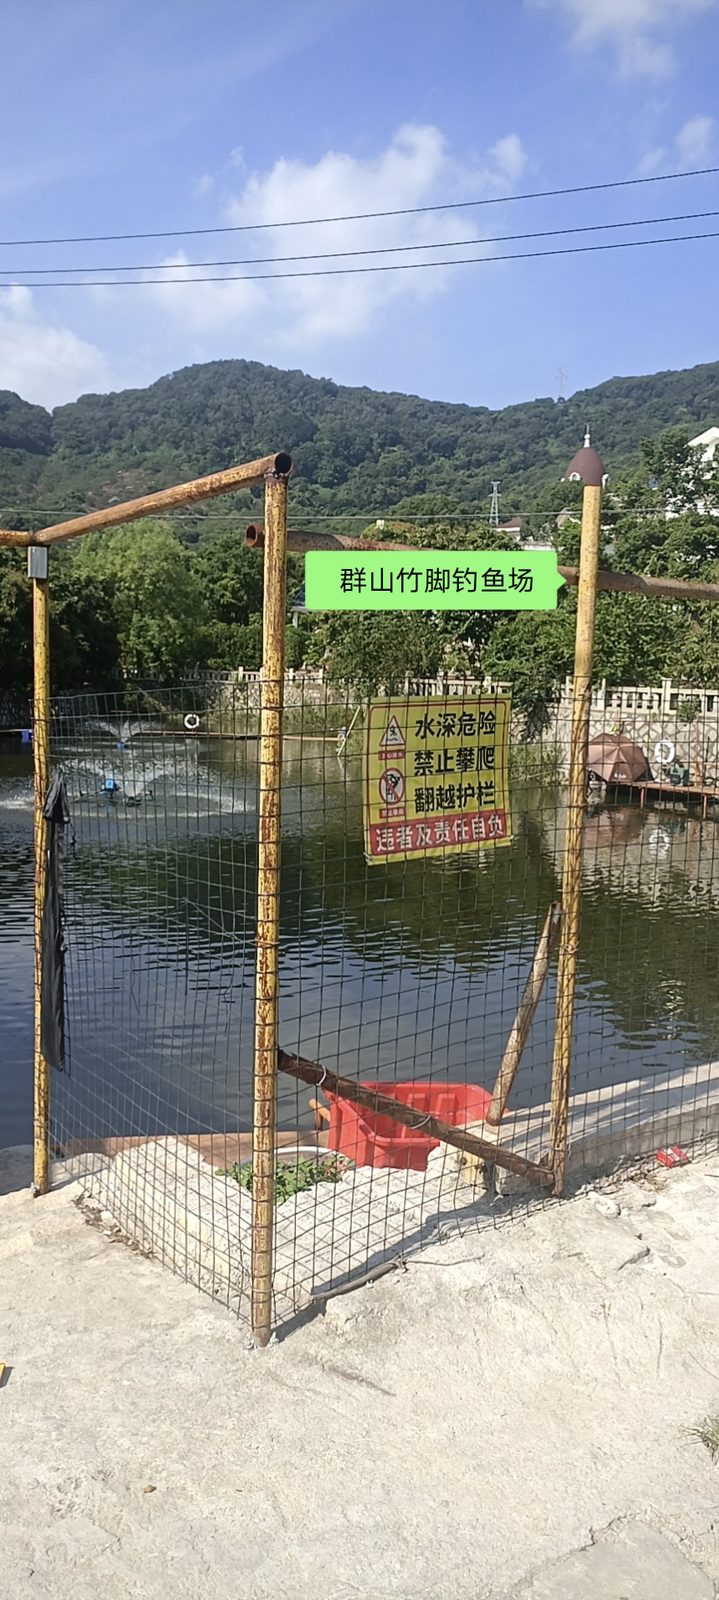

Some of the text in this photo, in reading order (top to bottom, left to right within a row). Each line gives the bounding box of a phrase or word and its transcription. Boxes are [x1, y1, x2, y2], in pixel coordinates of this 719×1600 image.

[415, 711, 496, 739] 水深危险
[414, 746, 495, 776] 禁止攀爬
[414, 781, 495, 814] 翻越护栏
[376, 815, 504, 852] 违者及责任自负
